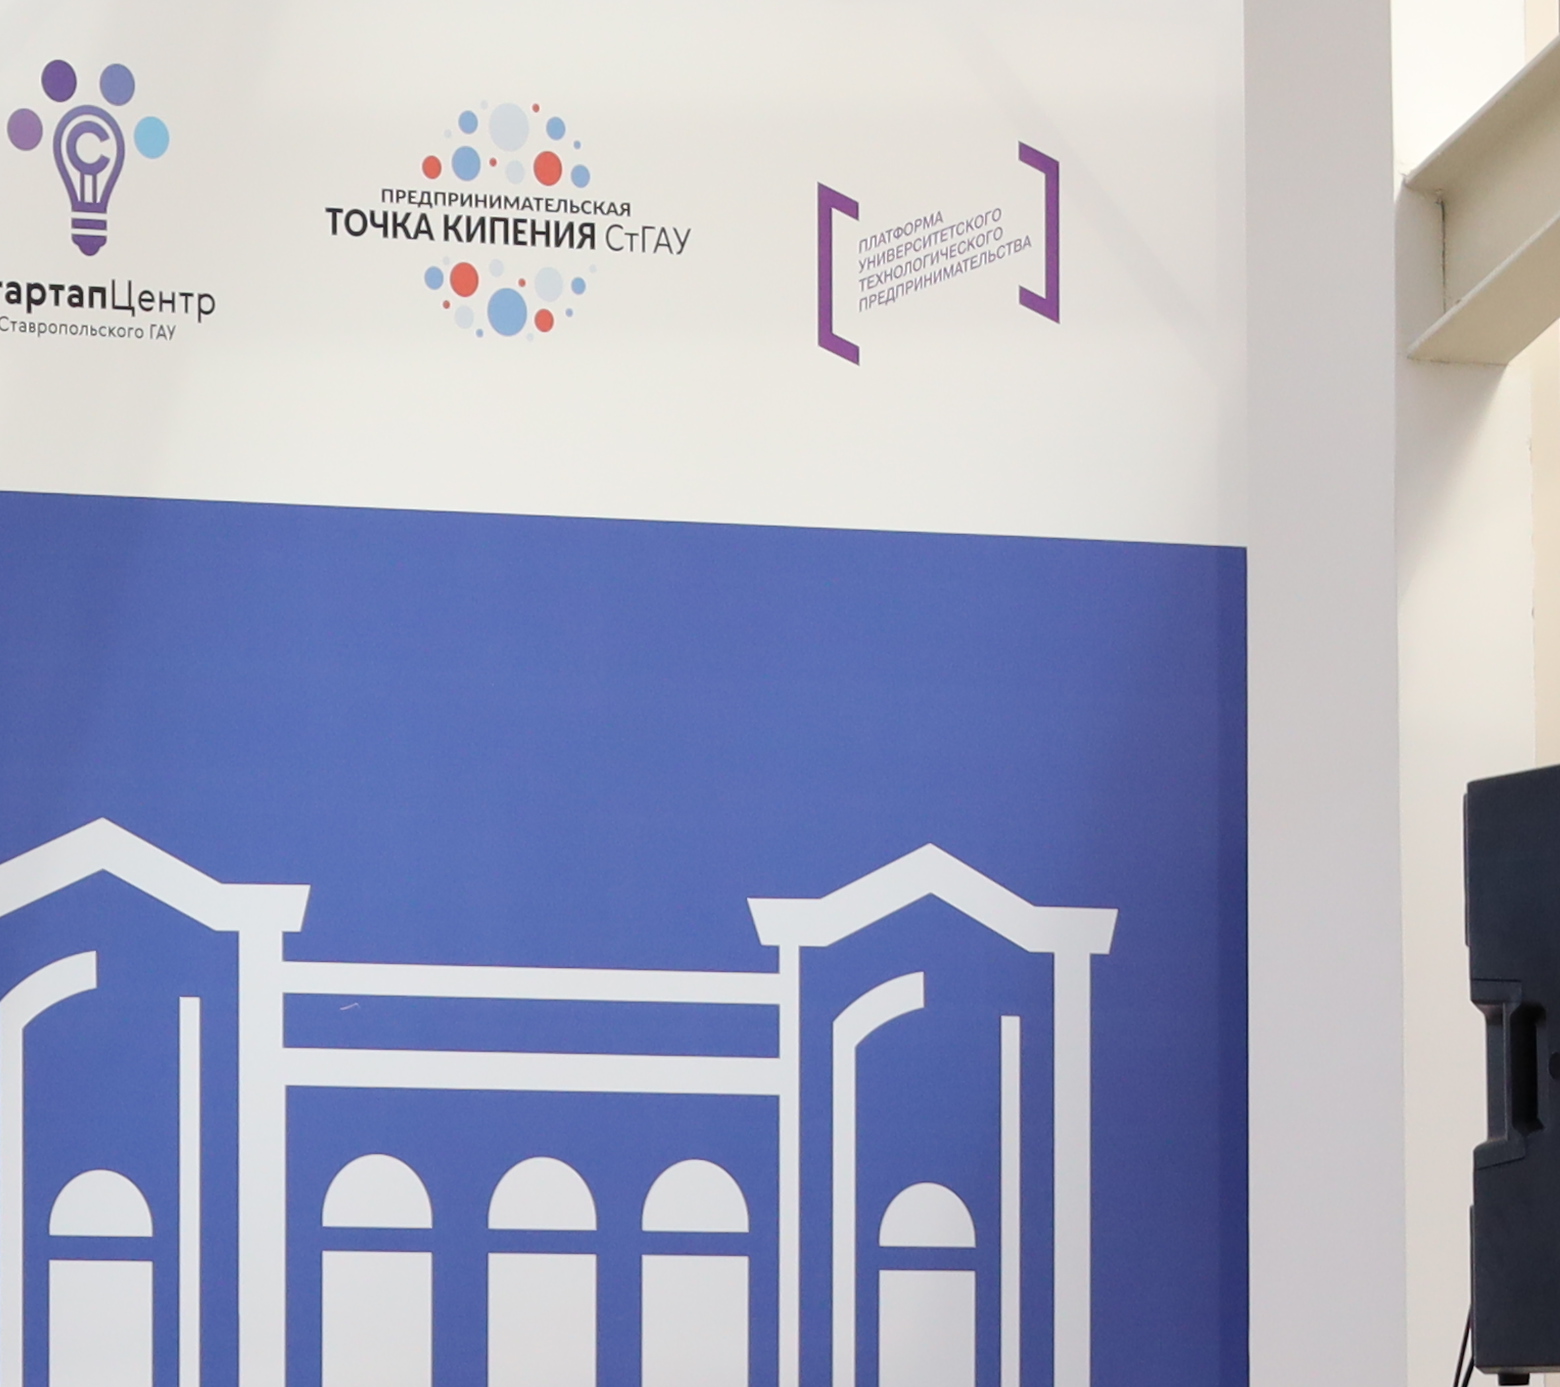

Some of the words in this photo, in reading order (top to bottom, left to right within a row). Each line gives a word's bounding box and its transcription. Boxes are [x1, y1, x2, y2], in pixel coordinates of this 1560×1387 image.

[381, 188, 631, 217] ПРЕДПРИНИМАТЕЛЬСКАЯ
[325, 206, 435, 241] ТОЧКА
[443, 214, 596, 250] КИПЕНИЯ
[605, 223, 691, 255] СтГАУ
[858, 211, 944, 254] ПЛАТФОРМА
[858, 207, 1002, 274] УНИВЕРСИТЕТСКОГО
[858, 226, 1004, 292] ТЕХНОЛОГИЧЕСКОГО
[859, 235, 1032, 313] ПРЕДПРИНИМАТЕЛЬСТВА
[149, 325, 177, 341] ГАУ
